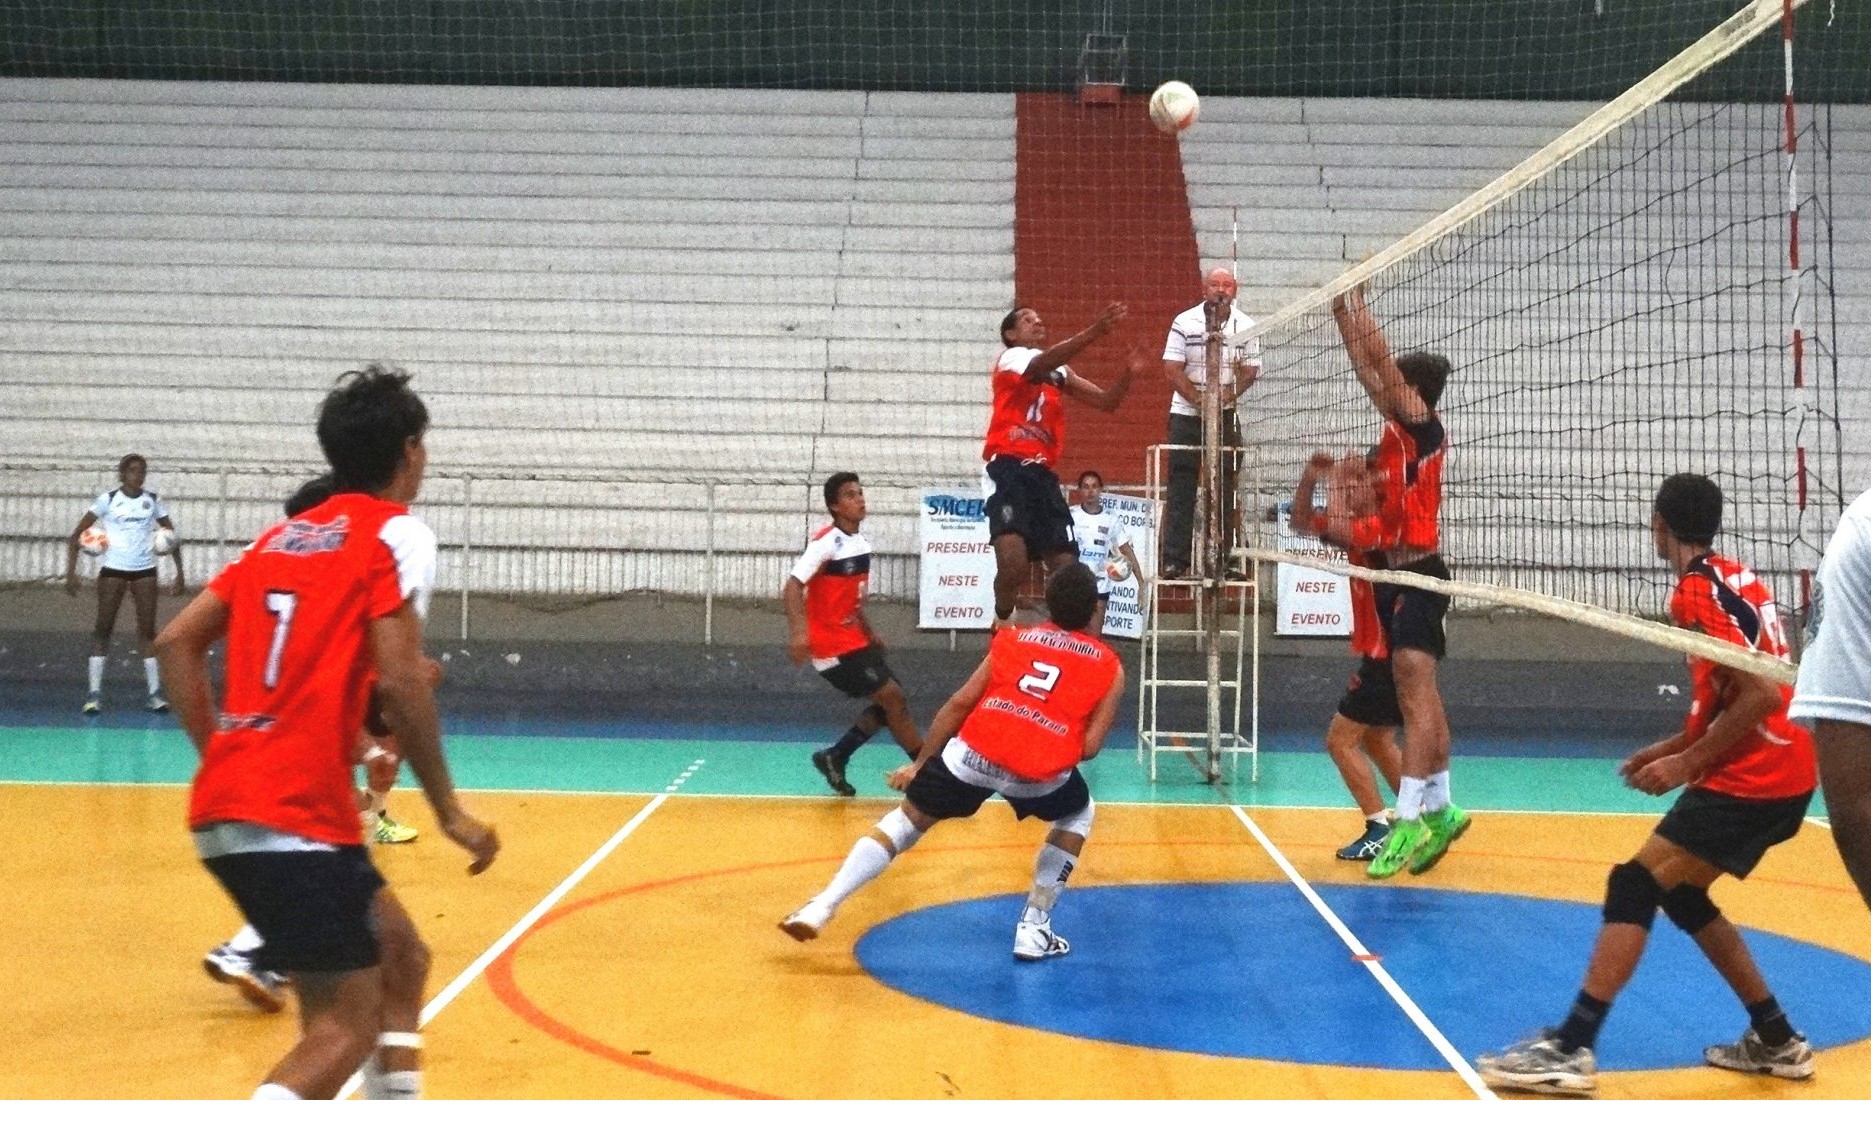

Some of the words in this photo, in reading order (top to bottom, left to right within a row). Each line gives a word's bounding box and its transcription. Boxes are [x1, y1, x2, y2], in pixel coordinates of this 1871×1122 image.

[926, 542, 991, 554] PRESENTE
[938, 575, 979, 587] NESTE
[1295, 581, 1337, 594] NESTE
[1110, 586, 1135, 599] ANDO
[934, 606, 984, 619] EVENTO
[1291, 613, 1341, 626] EVENTO
[263, 587, 297, 691] 7
[1017, 659, 1062, 704] 2
